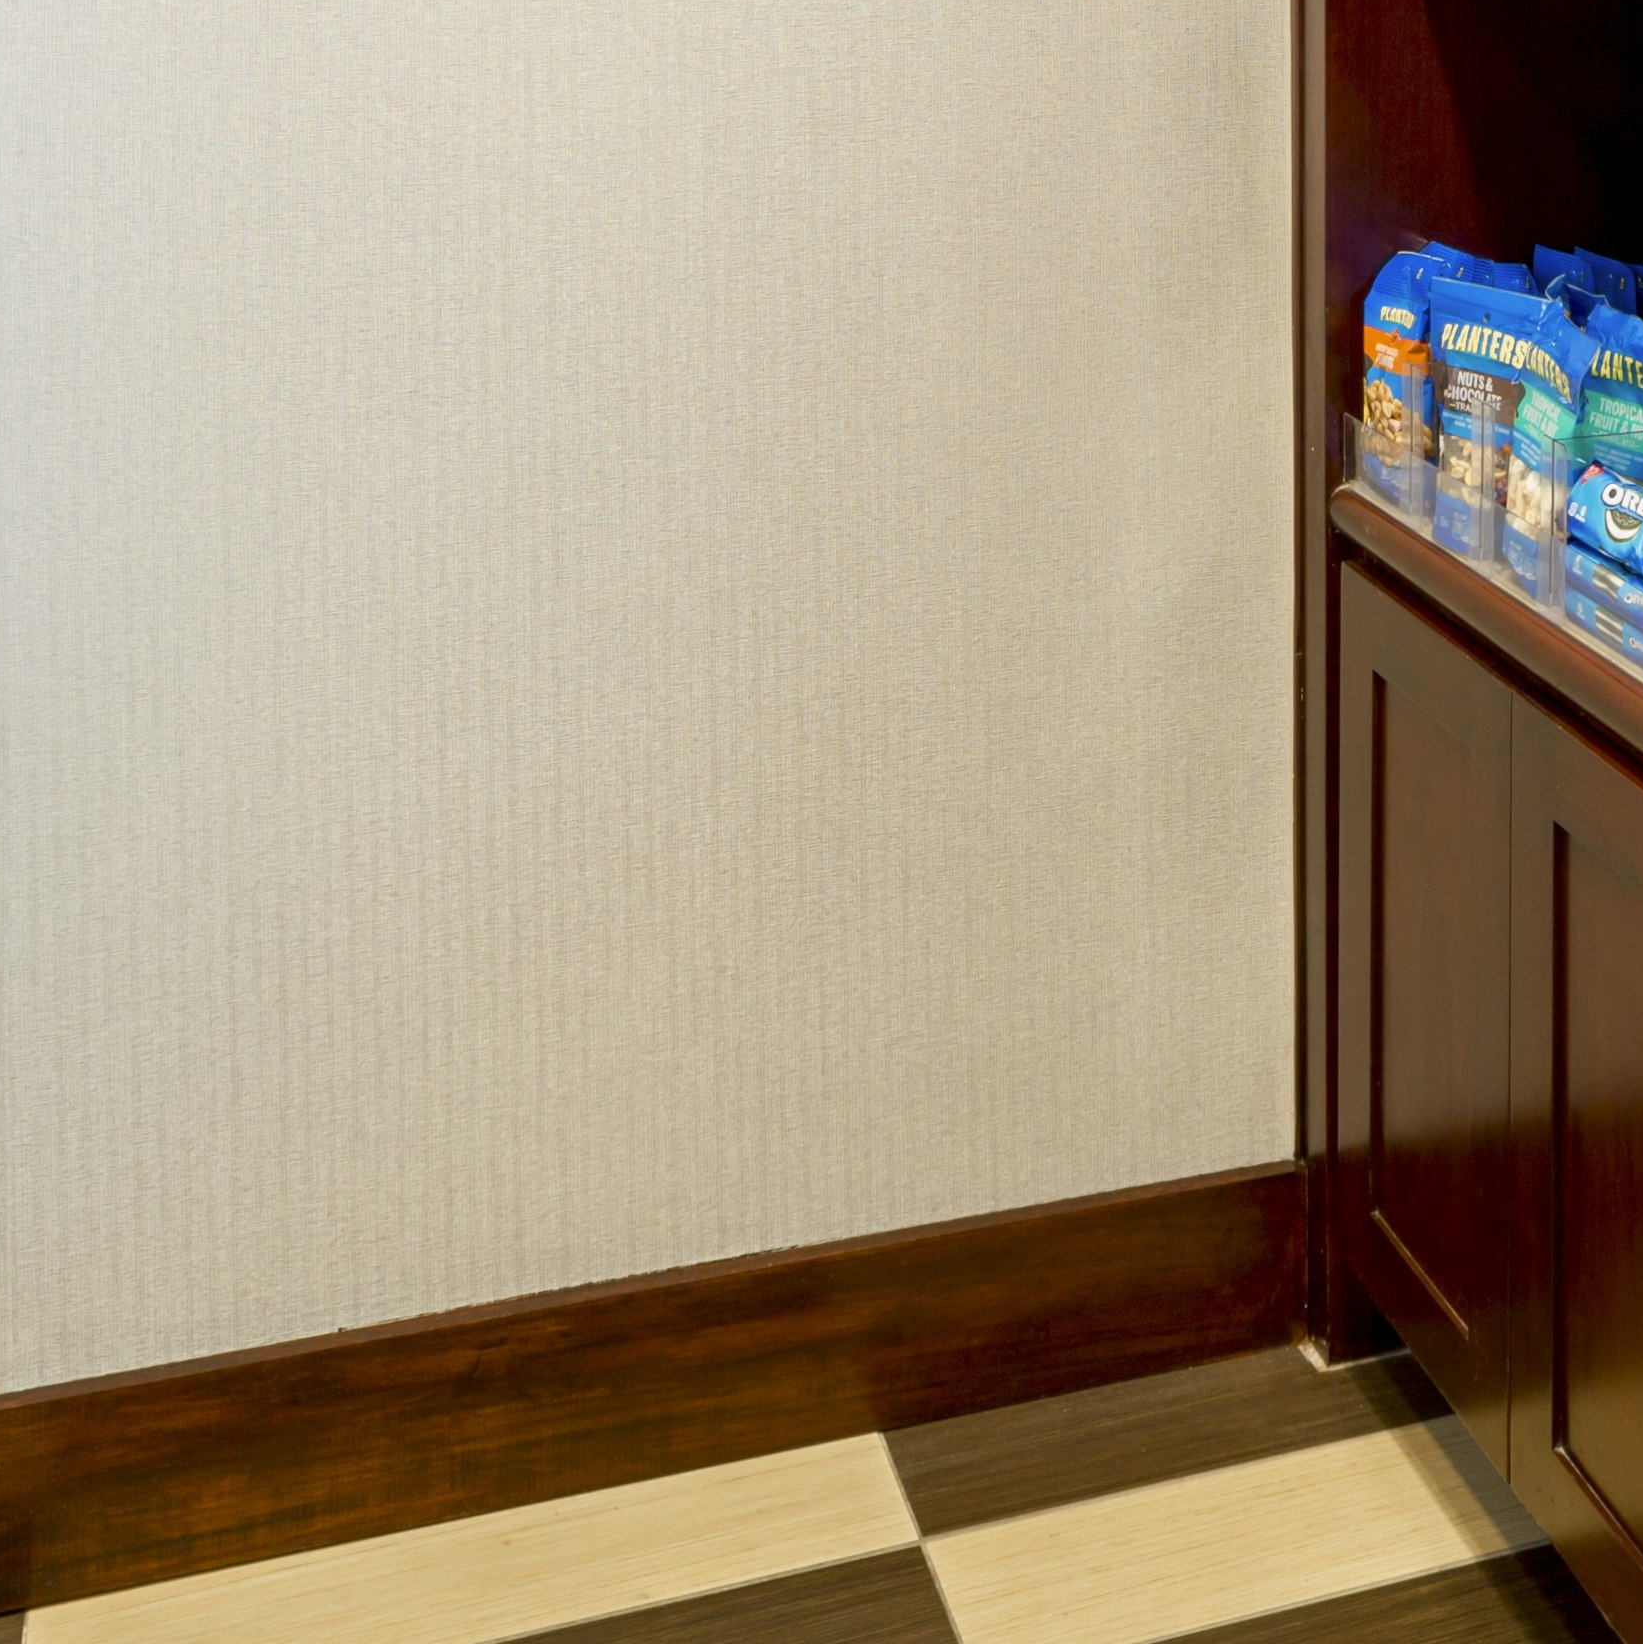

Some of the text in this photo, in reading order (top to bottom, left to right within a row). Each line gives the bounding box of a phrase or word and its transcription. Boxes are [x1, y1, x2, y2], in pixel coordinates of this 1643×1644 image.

[1441, 322, 1526, 370] PLANTERS
[1457, 370, 1485, 389] NUTS
[1524, 341, 1573, 404] LANTERS
[1589, 412, 1621, 435] FRUIT
